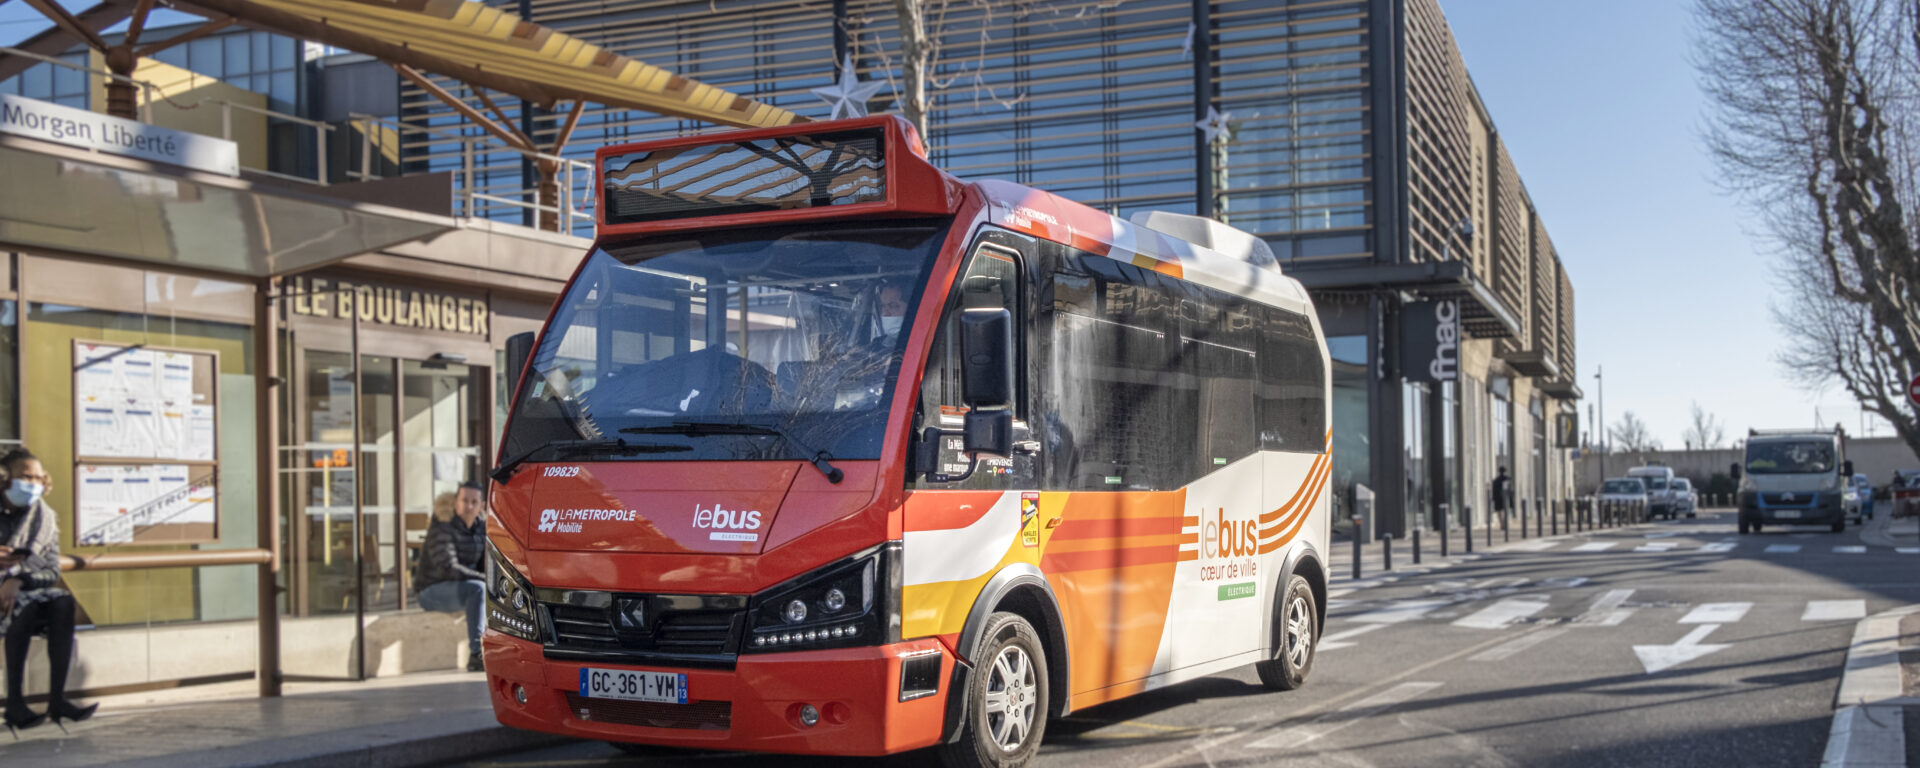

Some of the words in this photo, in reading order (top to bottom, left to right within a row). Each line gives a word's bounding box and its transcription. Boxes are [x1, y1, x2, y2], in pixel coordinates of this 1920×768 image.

[2, 102, 93, 140] Morgan
[102, 122, 177, 157] Liberté
[294, 275, 329, 317] LE
[336, 281, 489, 336] BOULANGER
[1429, 300, 1457, 381] fnac
[543, 466, 580, 477] 109829
[557, 522, 582, 532] Mobilité
[692, 503, 762, 530] lebus
[1200, 507, 1257, 560] lebus
[1200, 564, 1226, 582] cœur
[1226, 560, 1238, 579] de
[1239, 558, 1257, 577] ville
[591, 671, 676, 698] GC-361-VM
[678, 688, 688, 699] 13
